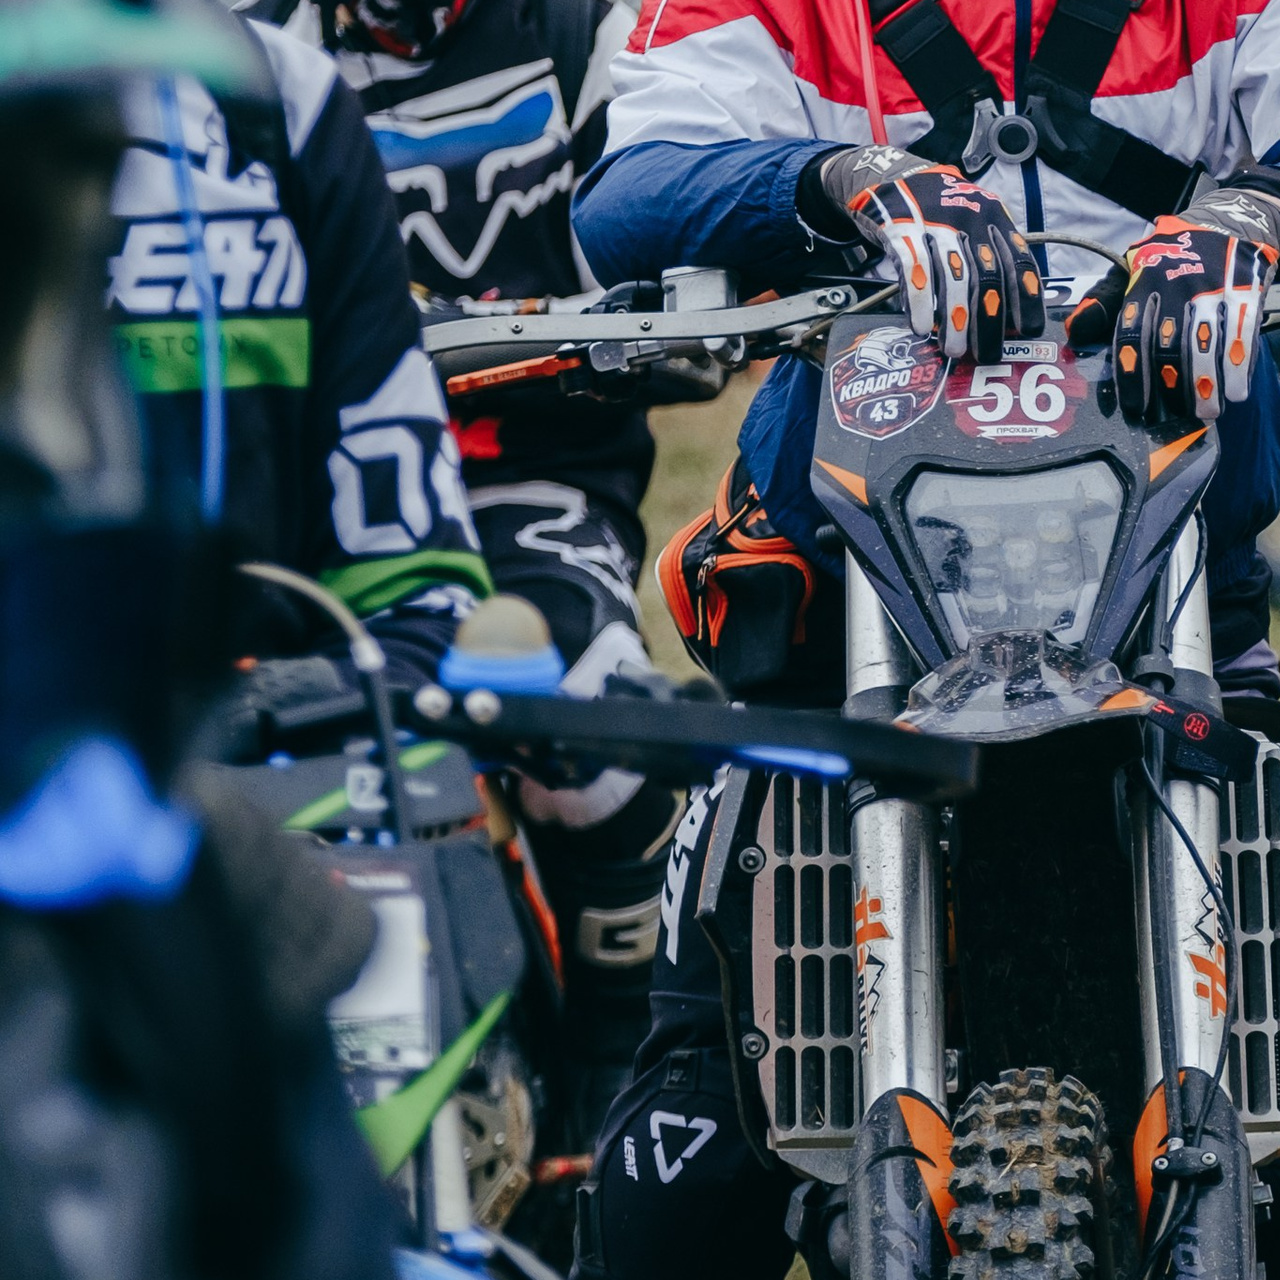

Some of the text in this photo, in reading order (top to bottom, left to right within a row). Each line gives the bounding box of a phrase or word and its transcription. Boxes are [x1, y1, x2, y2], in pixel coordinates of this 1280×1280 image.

[1165, 262, 1205, 281] Red Bull
[966, 364, 1066, 422] 56
[869, 398, 900, 422] 43
[996, 426, 1040, 435] ПРОХВАТ
